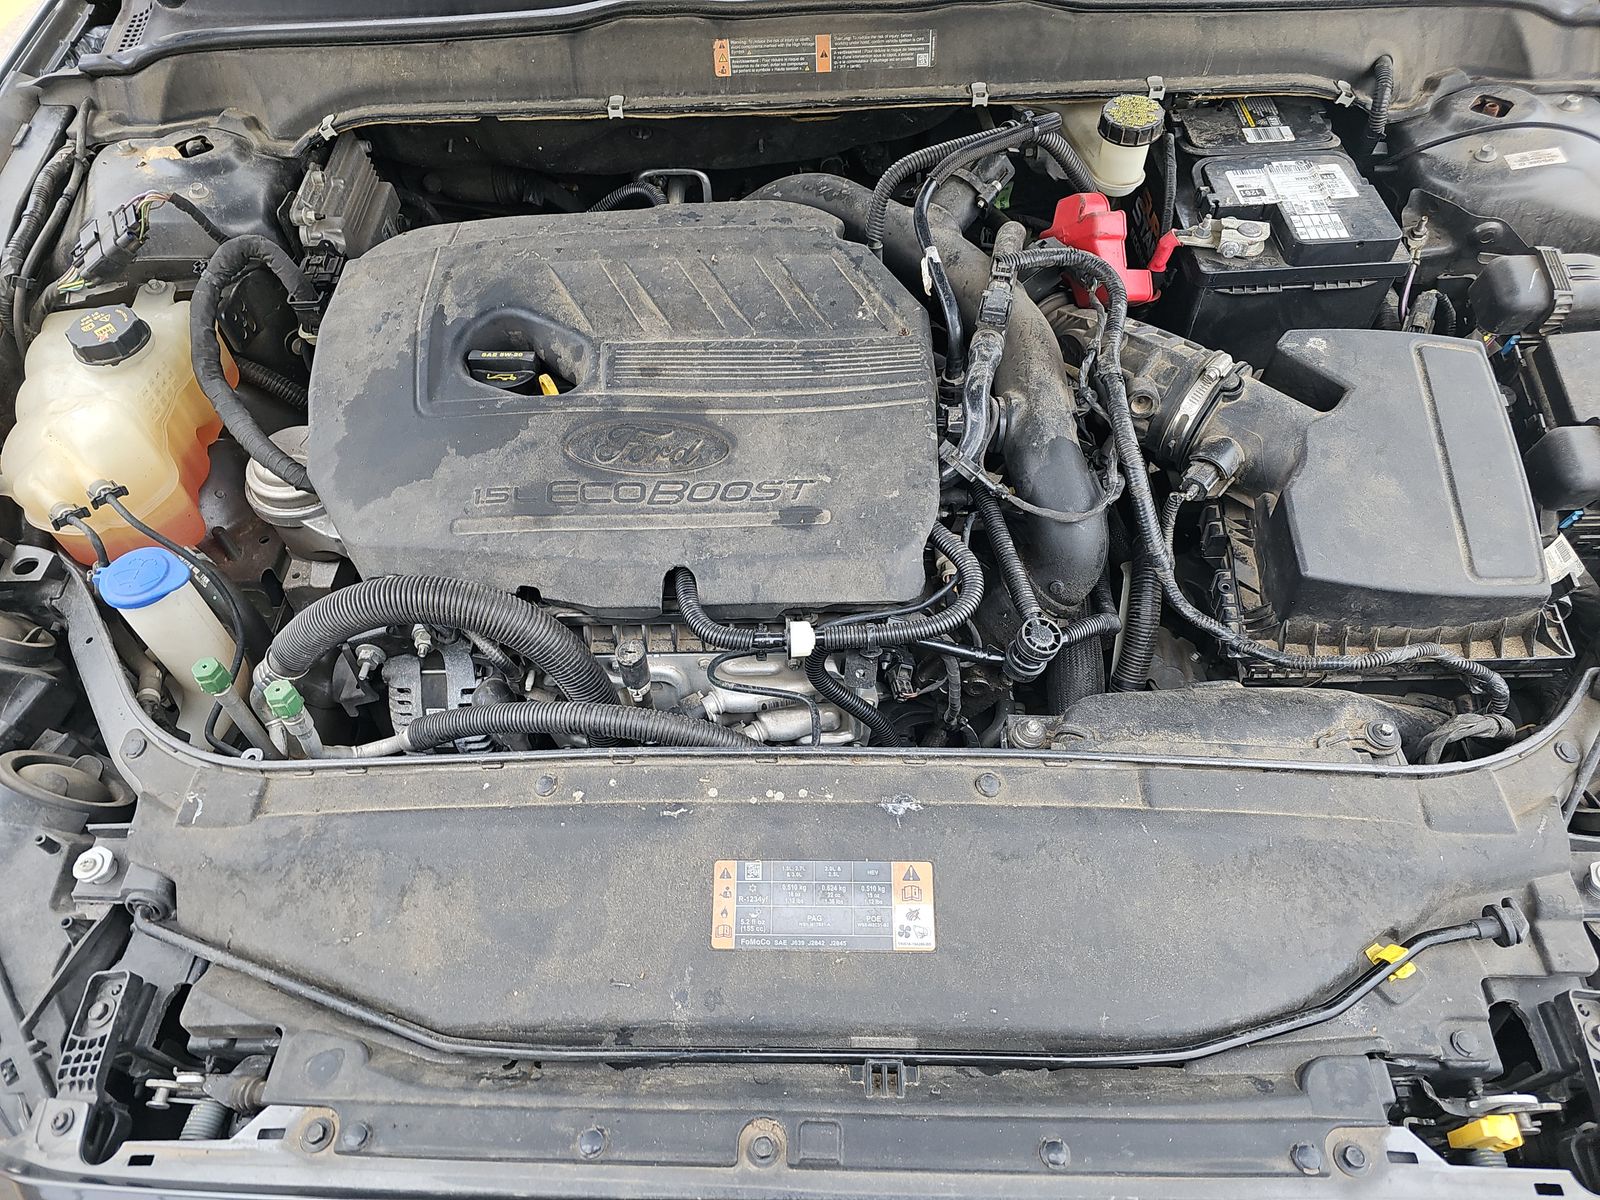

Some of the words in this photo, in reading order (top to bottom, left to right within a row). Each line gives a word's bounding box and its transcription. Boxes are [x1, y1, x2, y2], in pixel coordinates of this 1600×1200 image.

[594, 427, 704, 464] Ford
[799, 884, 807, 892] kg
[839, 884, 846, 893] kg
[739, 896, 769, 904] R-1234yf
